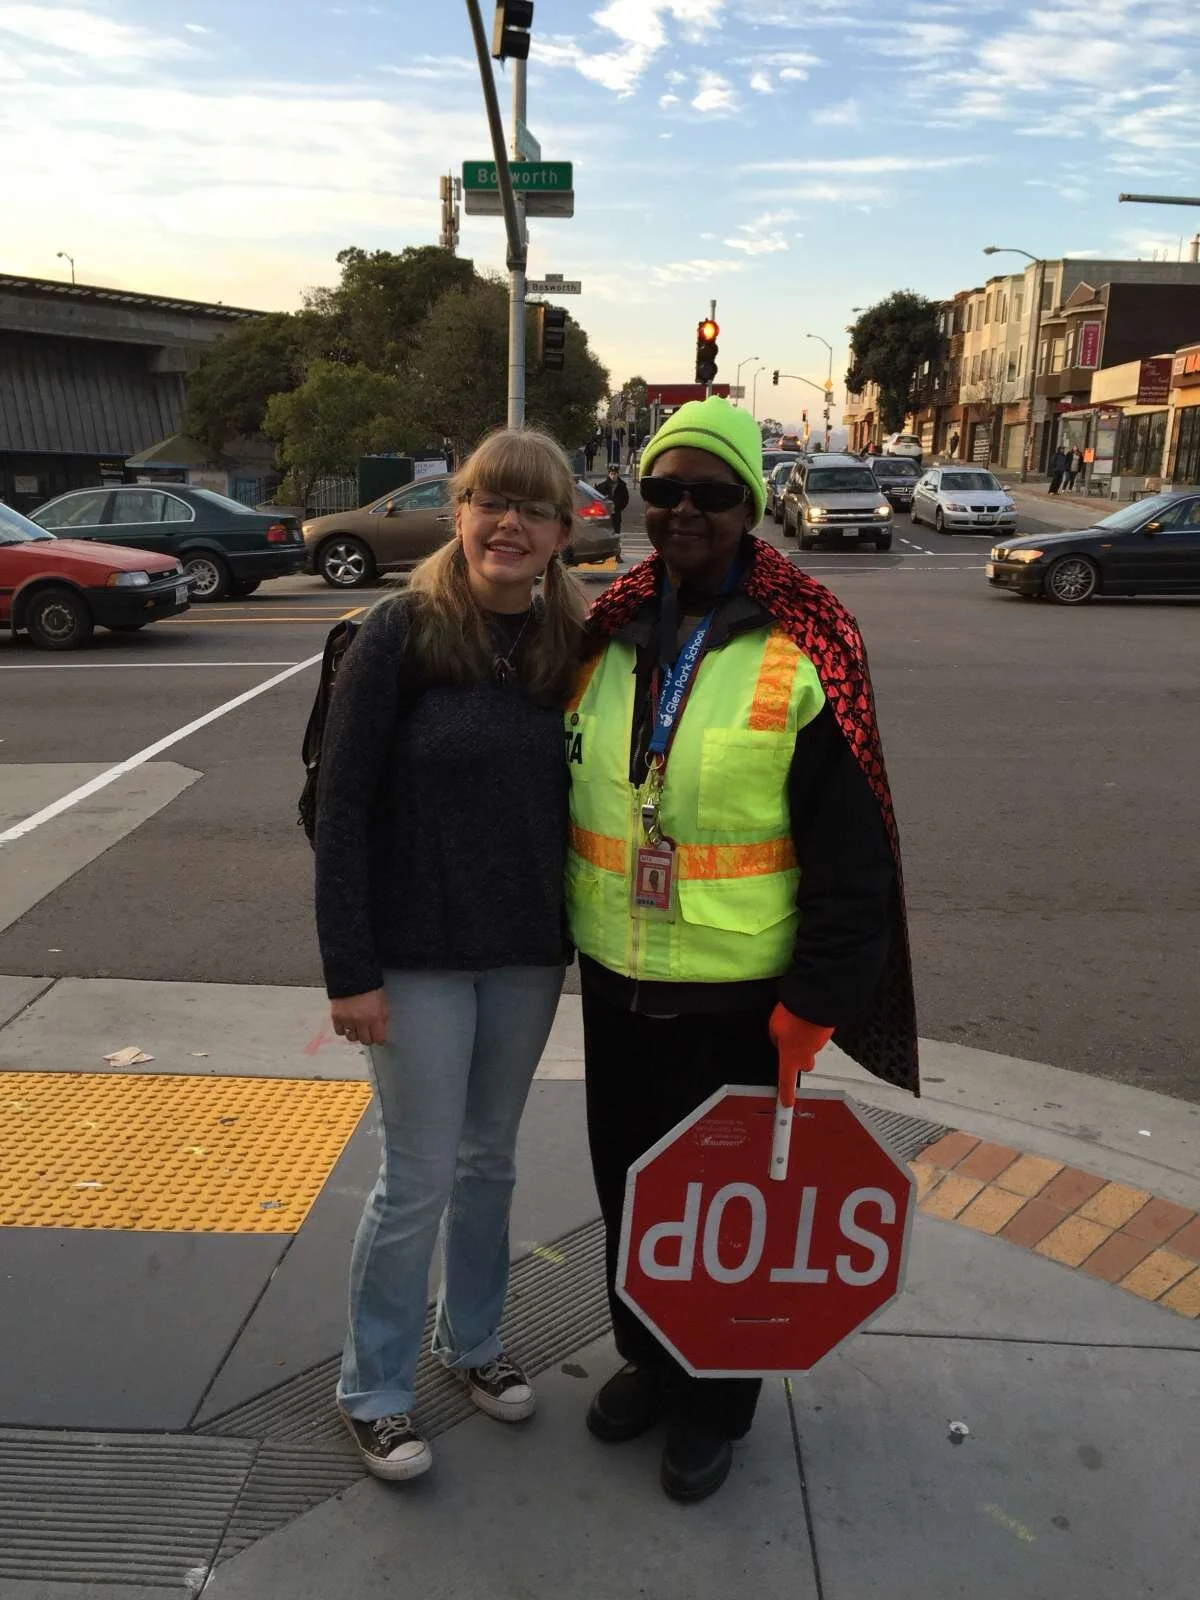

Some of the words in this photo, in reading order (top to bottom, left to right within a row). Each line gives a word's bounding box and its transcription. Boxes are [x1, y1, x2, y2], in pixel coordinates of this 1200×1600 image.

[478, 168, 558, 184] Boworth
[532, 283, 577, 292] Bosworth
[665, 690, 682, 714] Glen
[675, 663, 693, 689] Park
[685, 629, 706, 662] School
[638, 1182, 897, 1287] STOP
